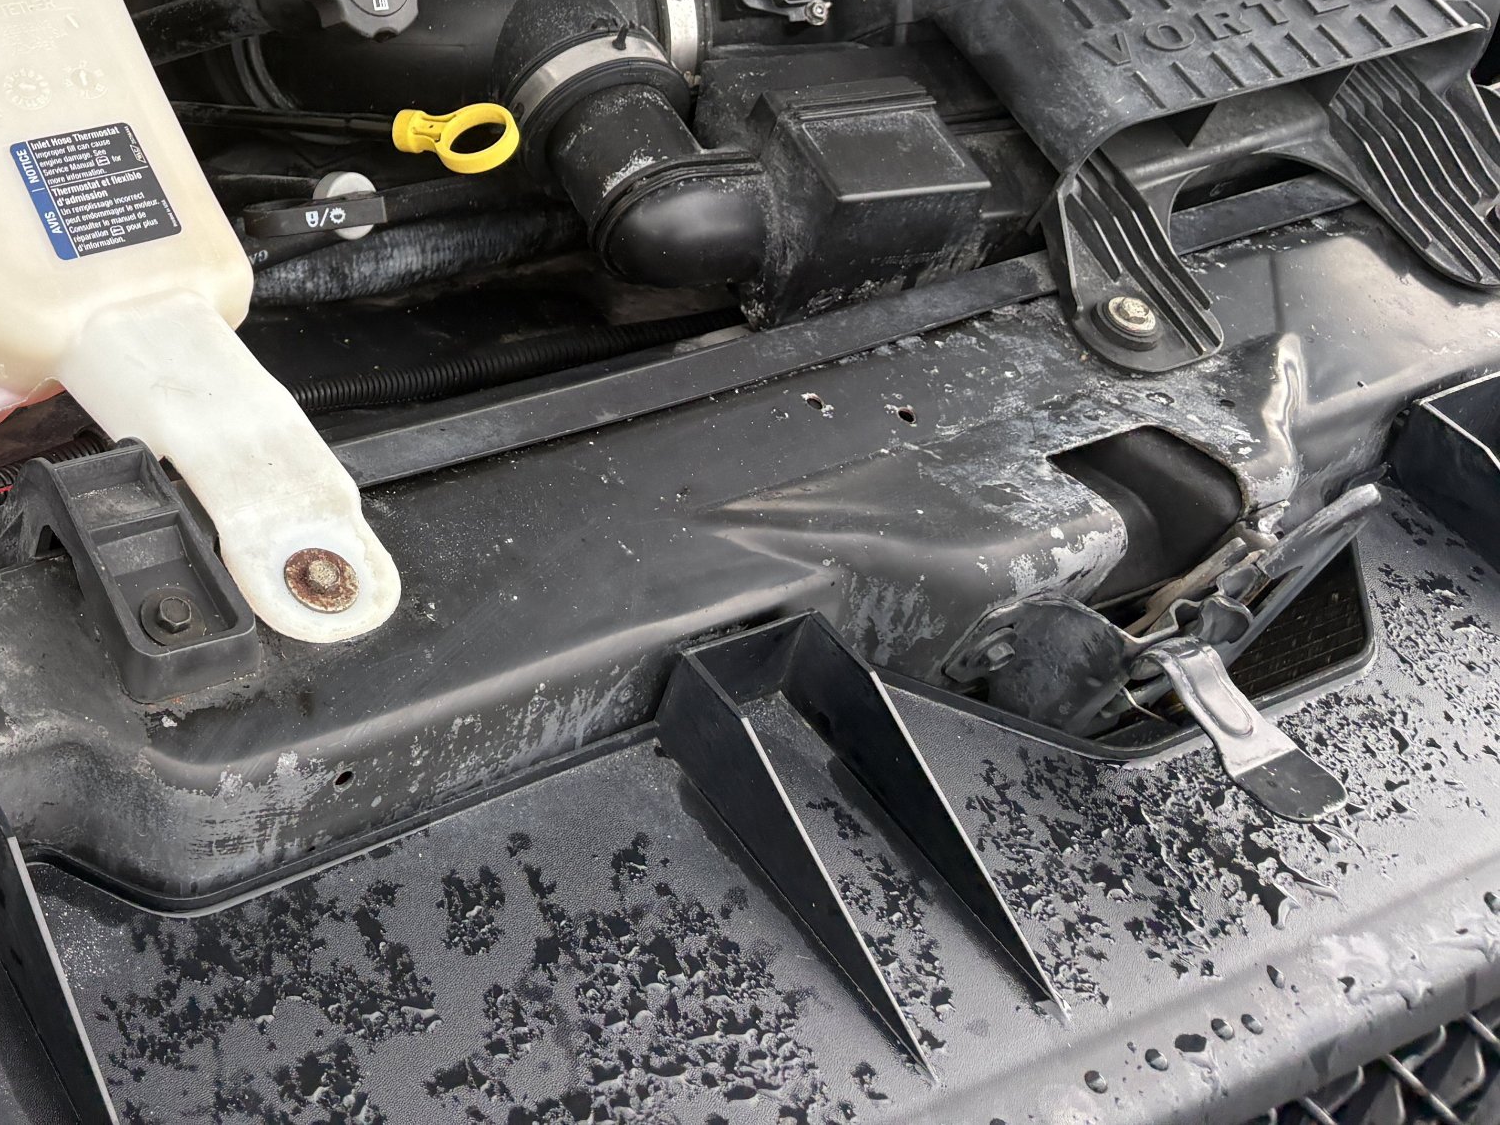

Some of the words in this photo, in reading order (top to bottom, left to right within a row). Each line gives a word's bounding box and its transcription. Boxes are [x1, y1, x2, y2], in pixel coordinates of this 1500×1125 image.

[31, 141, 51, 150] Inlet
[51, 136, 72, 147] Hose
[72, 126, 120, 142] Thermostat
[35, 148, 66, 159] Improper
[67, 145, 76, 153] fill
[90, 139, 111, 148] cause
[16, 149, 39, 184] NOTICE
[39, 157, 63, 168] engine
[63, 152, 93, 163] damage.
[43, 165, 69, 177] Service
[69, 160, 95, 171] Manual
[47, 176, 66, 186] more
[65, 168, 107, 182] information.
[51, 179, 100, 197] Thermostat
[100, 177, 111, 187] et
[111, 172, 143, 185] flexible
[57, 189, 108, 207] d'admission
[60, 208, 72, 216] Un
[72, 199, 114, 214] remplissage
[113, 191, 145, 205] incorrect
[45, 212, 63, 234] AVIS
[65, 216, 81, 226] peut
[82, 206, 125, 221] endommager
[133, 198, 160, 210] moteur.
[69, 221, 102, 234] Consulter
[110, 212, 137, 225] manuel
[137, 211, 147, 219] de
[73, 229, 109, 243] réparation
[126, 222, 142, 233] pour
[142, 218, 159, 229] plus
[77, 235, 126, 252] d'information.
[249, 250, 268, 264] GA
